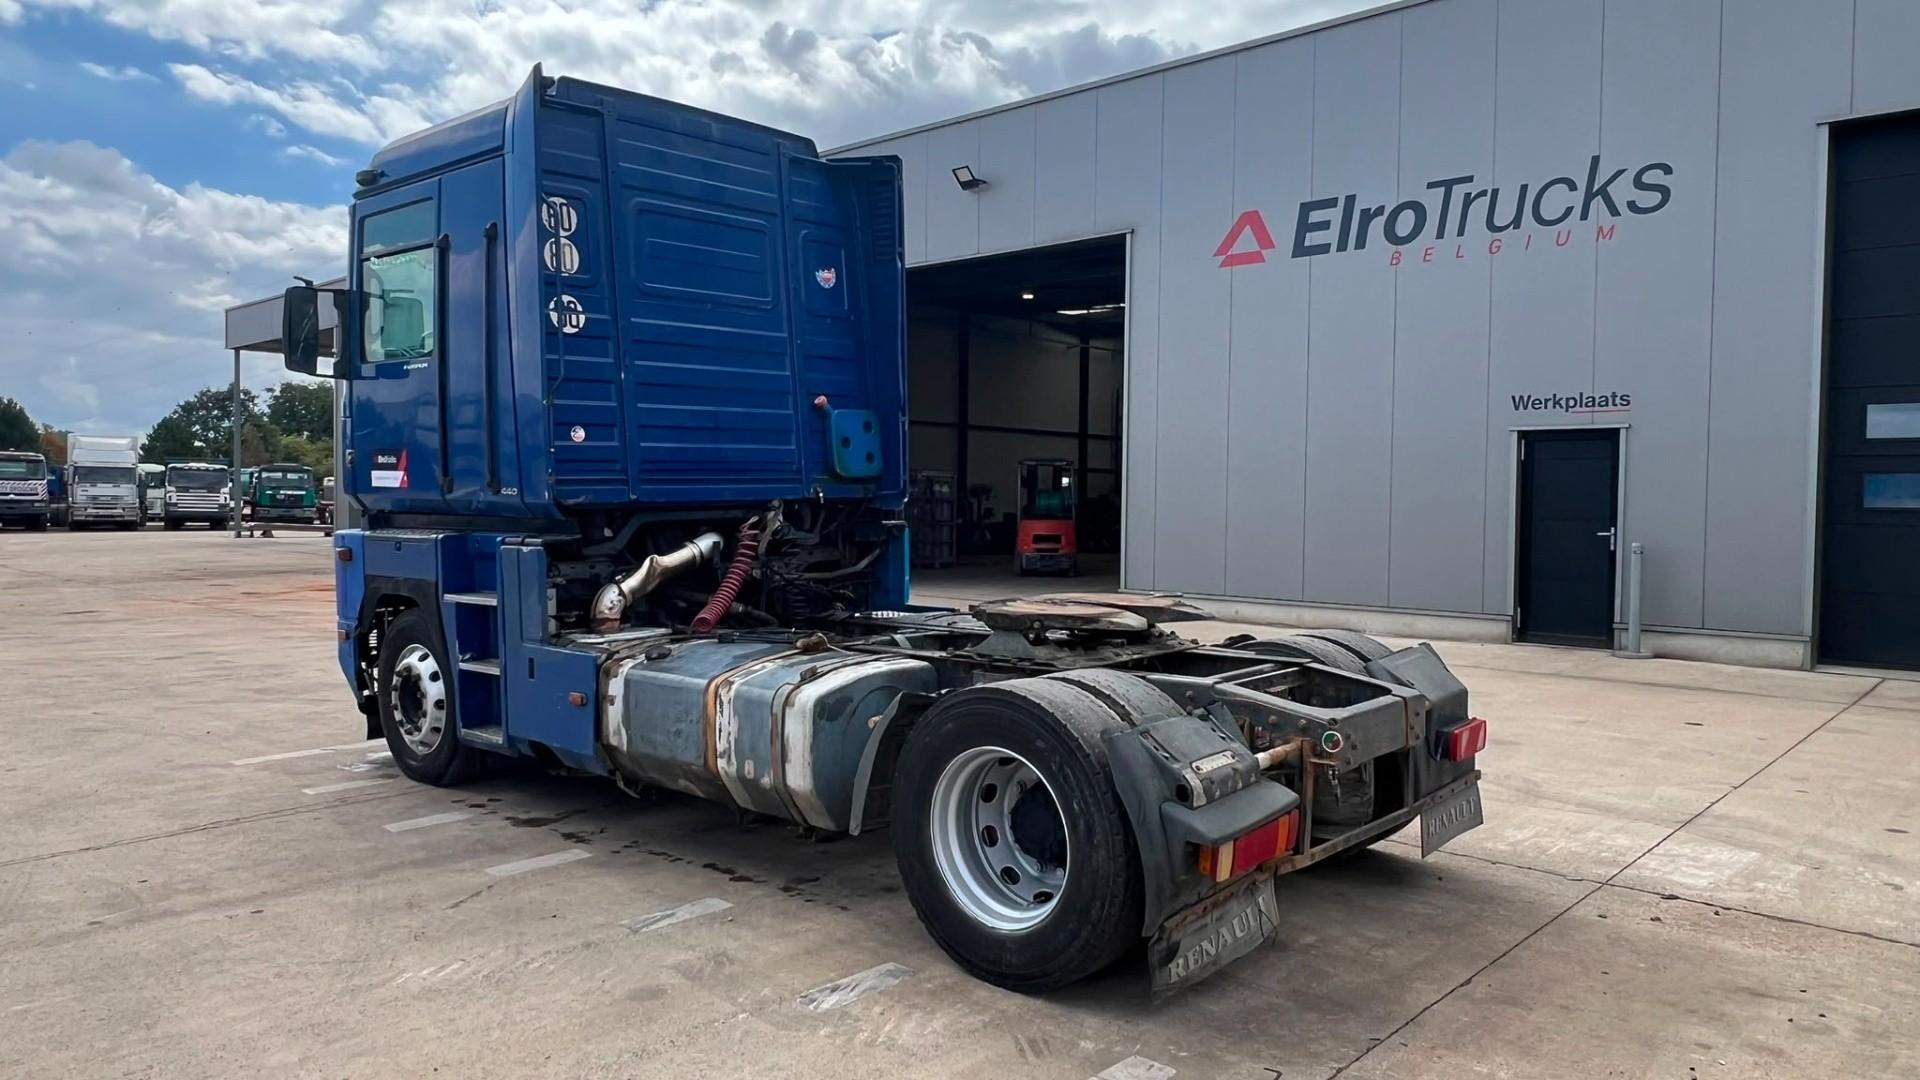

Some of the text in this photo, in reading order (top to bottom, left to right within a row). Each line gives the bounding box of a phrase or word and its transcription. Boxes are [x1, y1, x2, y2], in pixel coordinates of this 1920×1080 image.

[1291, 155, 1675, 259] ElroTrucks
[1389, 224, 1616, 267] BELGIUM
[1511, 391, 1631, 413] Werkplaats
[1427, 797, 1477, 839] RENAULT
